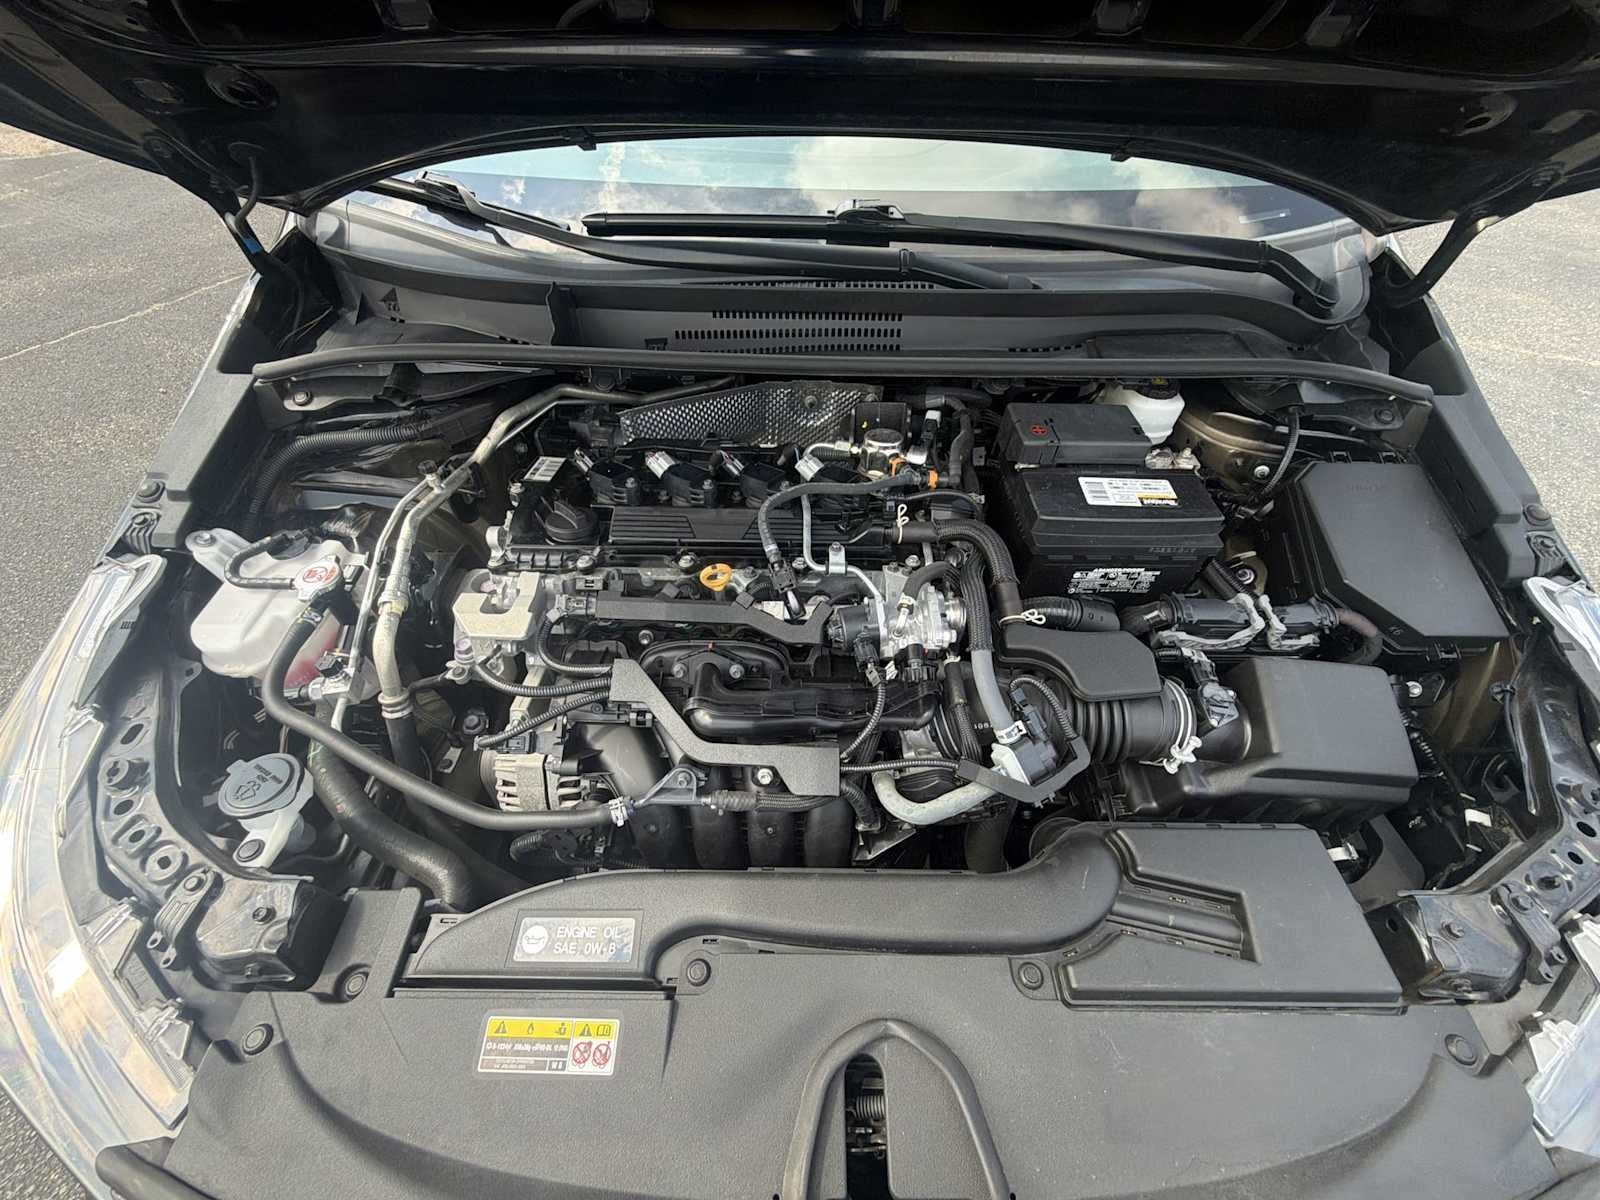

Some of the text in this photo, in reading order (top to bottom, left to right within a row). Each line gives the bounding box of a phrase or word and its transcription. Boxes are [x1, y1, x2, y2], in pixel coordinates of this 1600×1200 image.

[556, 926, 622, 938] ENGINE OIL
[553, 941, 578, 954] SAE
